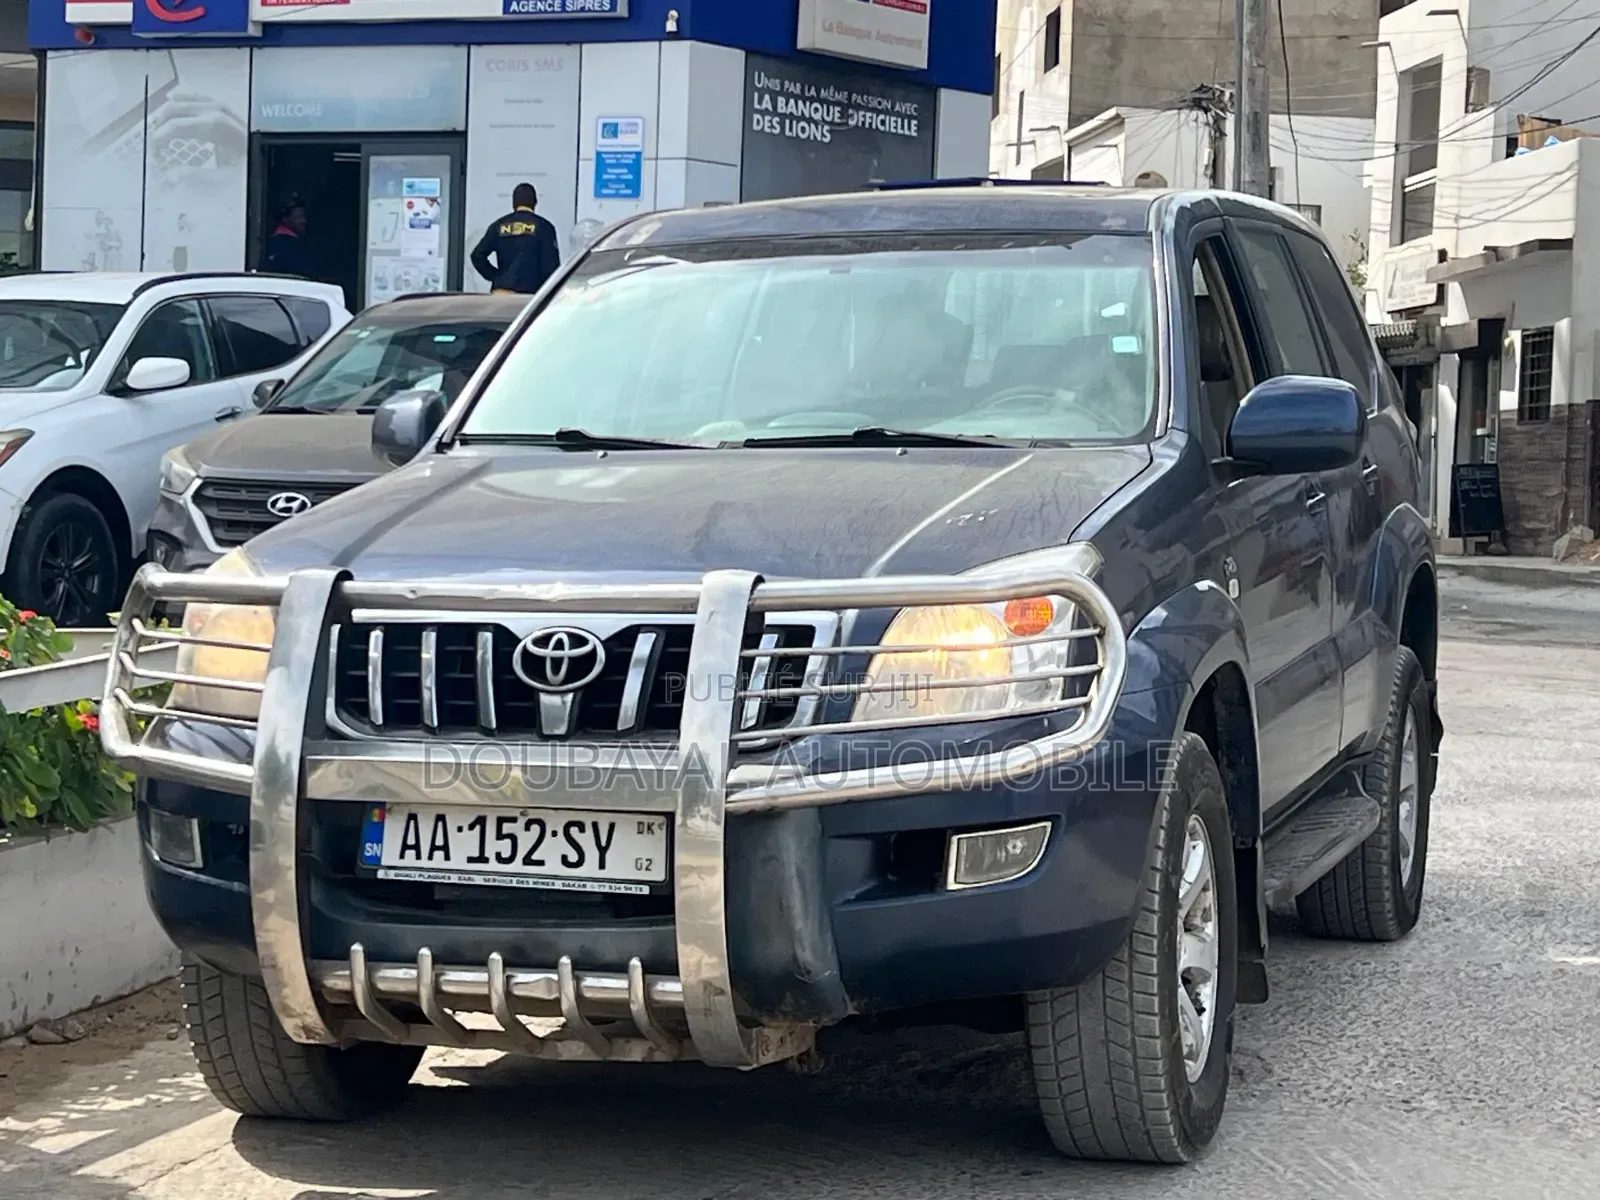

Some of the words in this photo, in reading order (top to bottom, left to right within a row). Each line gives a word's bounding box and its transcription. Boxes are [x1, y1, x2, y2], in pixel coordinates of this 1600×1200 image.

[509, 0, 562, 12] AGENCE
[565, 0, 611, 11] SIPRES
[783, 80, 801, 95] PAR
[804, 84, 817, 98] LA
[820, 85, 849, 104] MÊME
[851, 92, 892, 112] PASSION
[894, 102, 919, 116] AVEC
[754, 92, 773, 112] LA
[777, 96, 842, 123] BANQUE
[848, 108, 919, 137] OFFICIELLE
[752, 114, 781, 134] DES
[784, 118, 832, 143] LIONS
[636, 821, 655, 835] DK
[364, 842, 382, 857] SN
